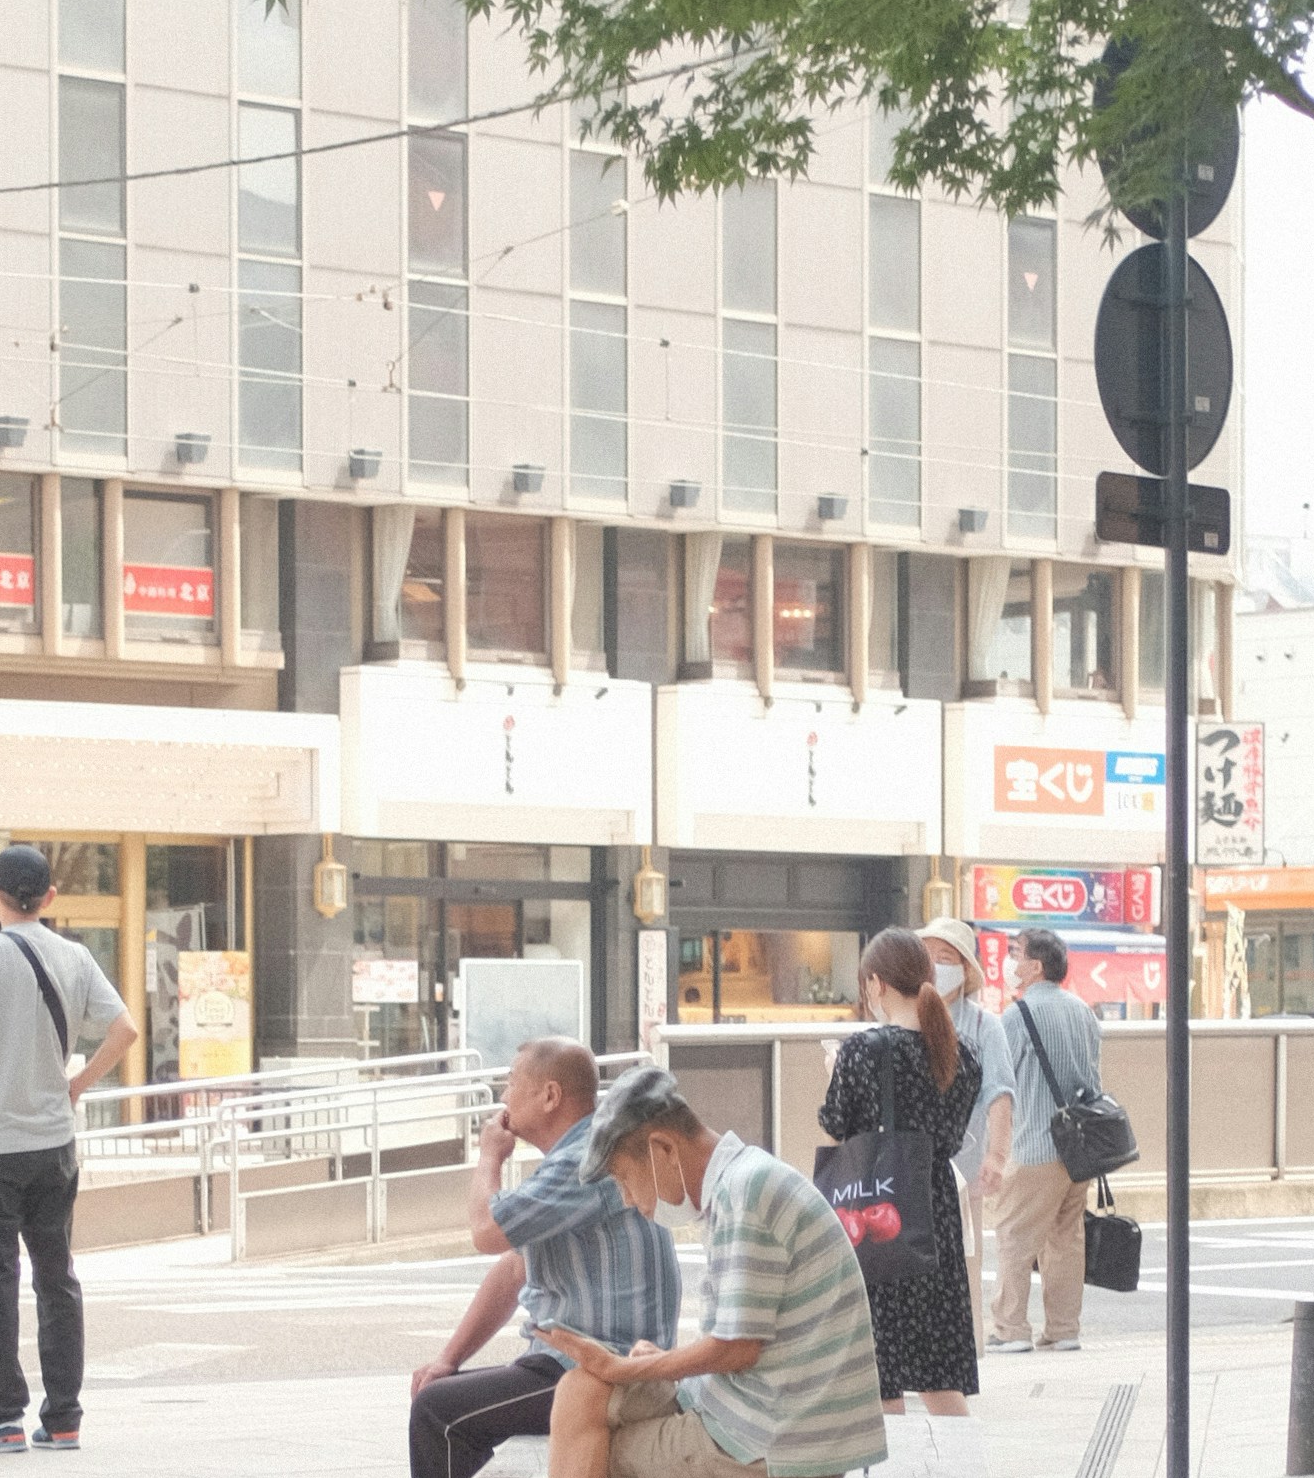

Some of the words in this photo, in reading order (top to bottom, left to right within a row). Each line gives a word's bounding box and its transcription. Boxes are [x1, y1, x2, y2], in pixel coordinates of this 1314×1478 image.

[1005, 758, 1094, 803] 宝くじ
[1198, 729, 1244, 828] つけ麺
[832, 1176, 895, 1205] MILK
